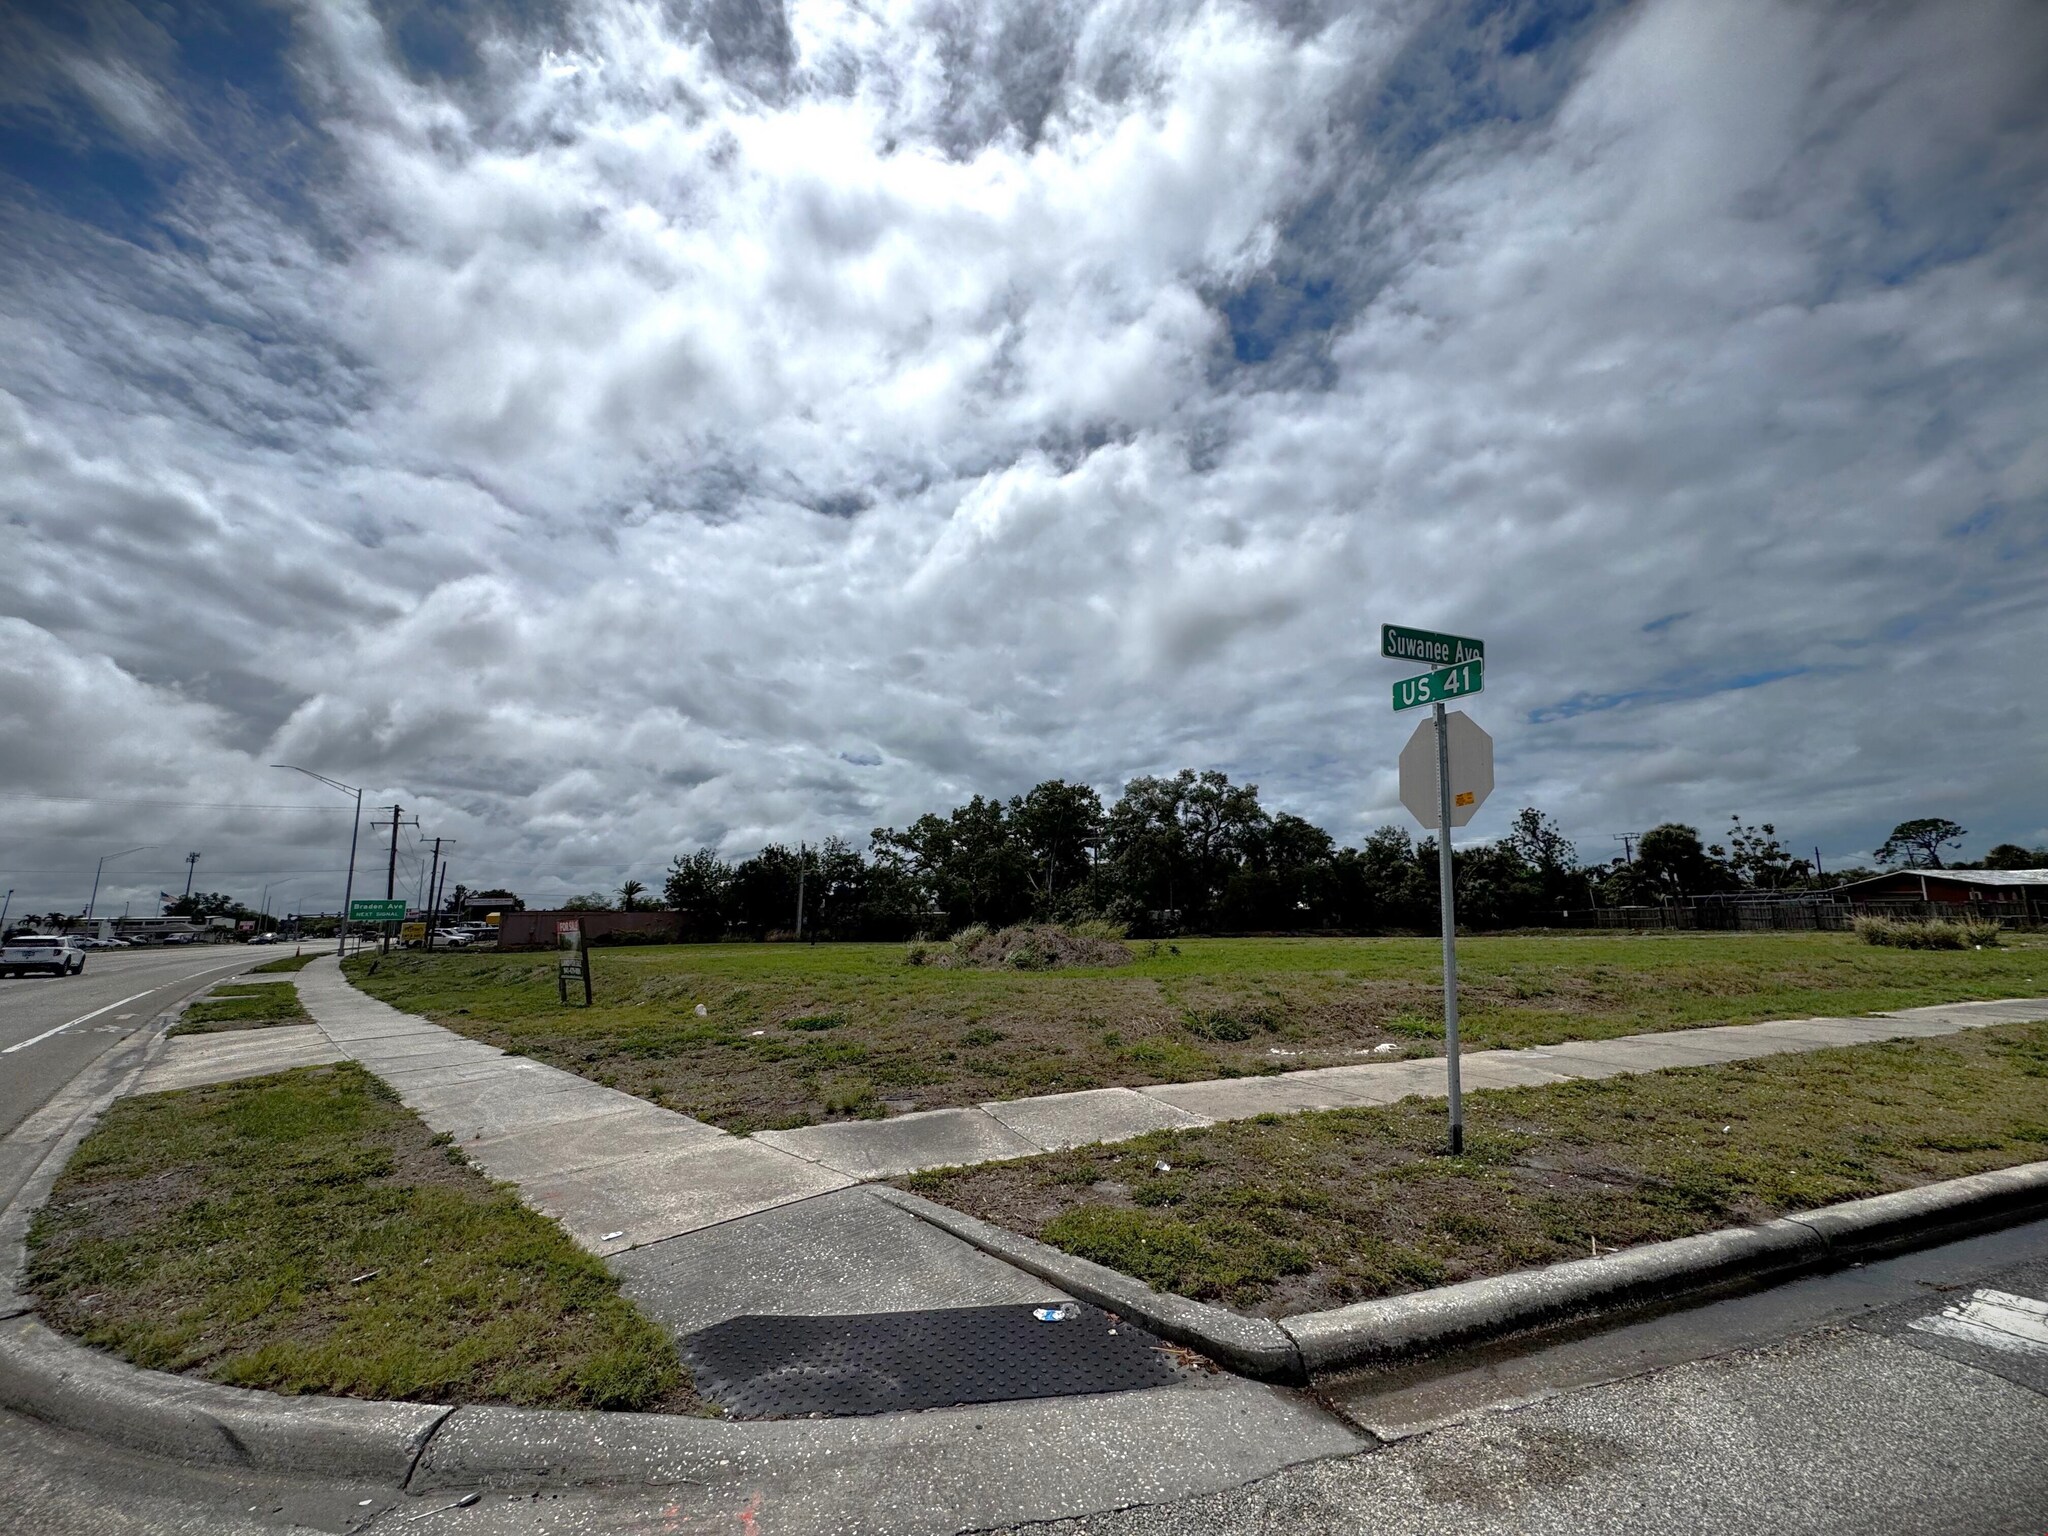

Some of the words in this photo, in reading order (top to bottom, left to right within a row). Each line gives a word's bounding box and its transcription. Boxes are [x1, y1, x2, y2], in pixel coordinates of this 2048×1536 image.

[1387, 629, 1449, 661] Suwanee
[1455, 640, 1480, 662] Ave
[1402, 677, 1431, 705] US
[1443, 666, 1470, 693] 41
[559, 921, 569, 931] FOR
